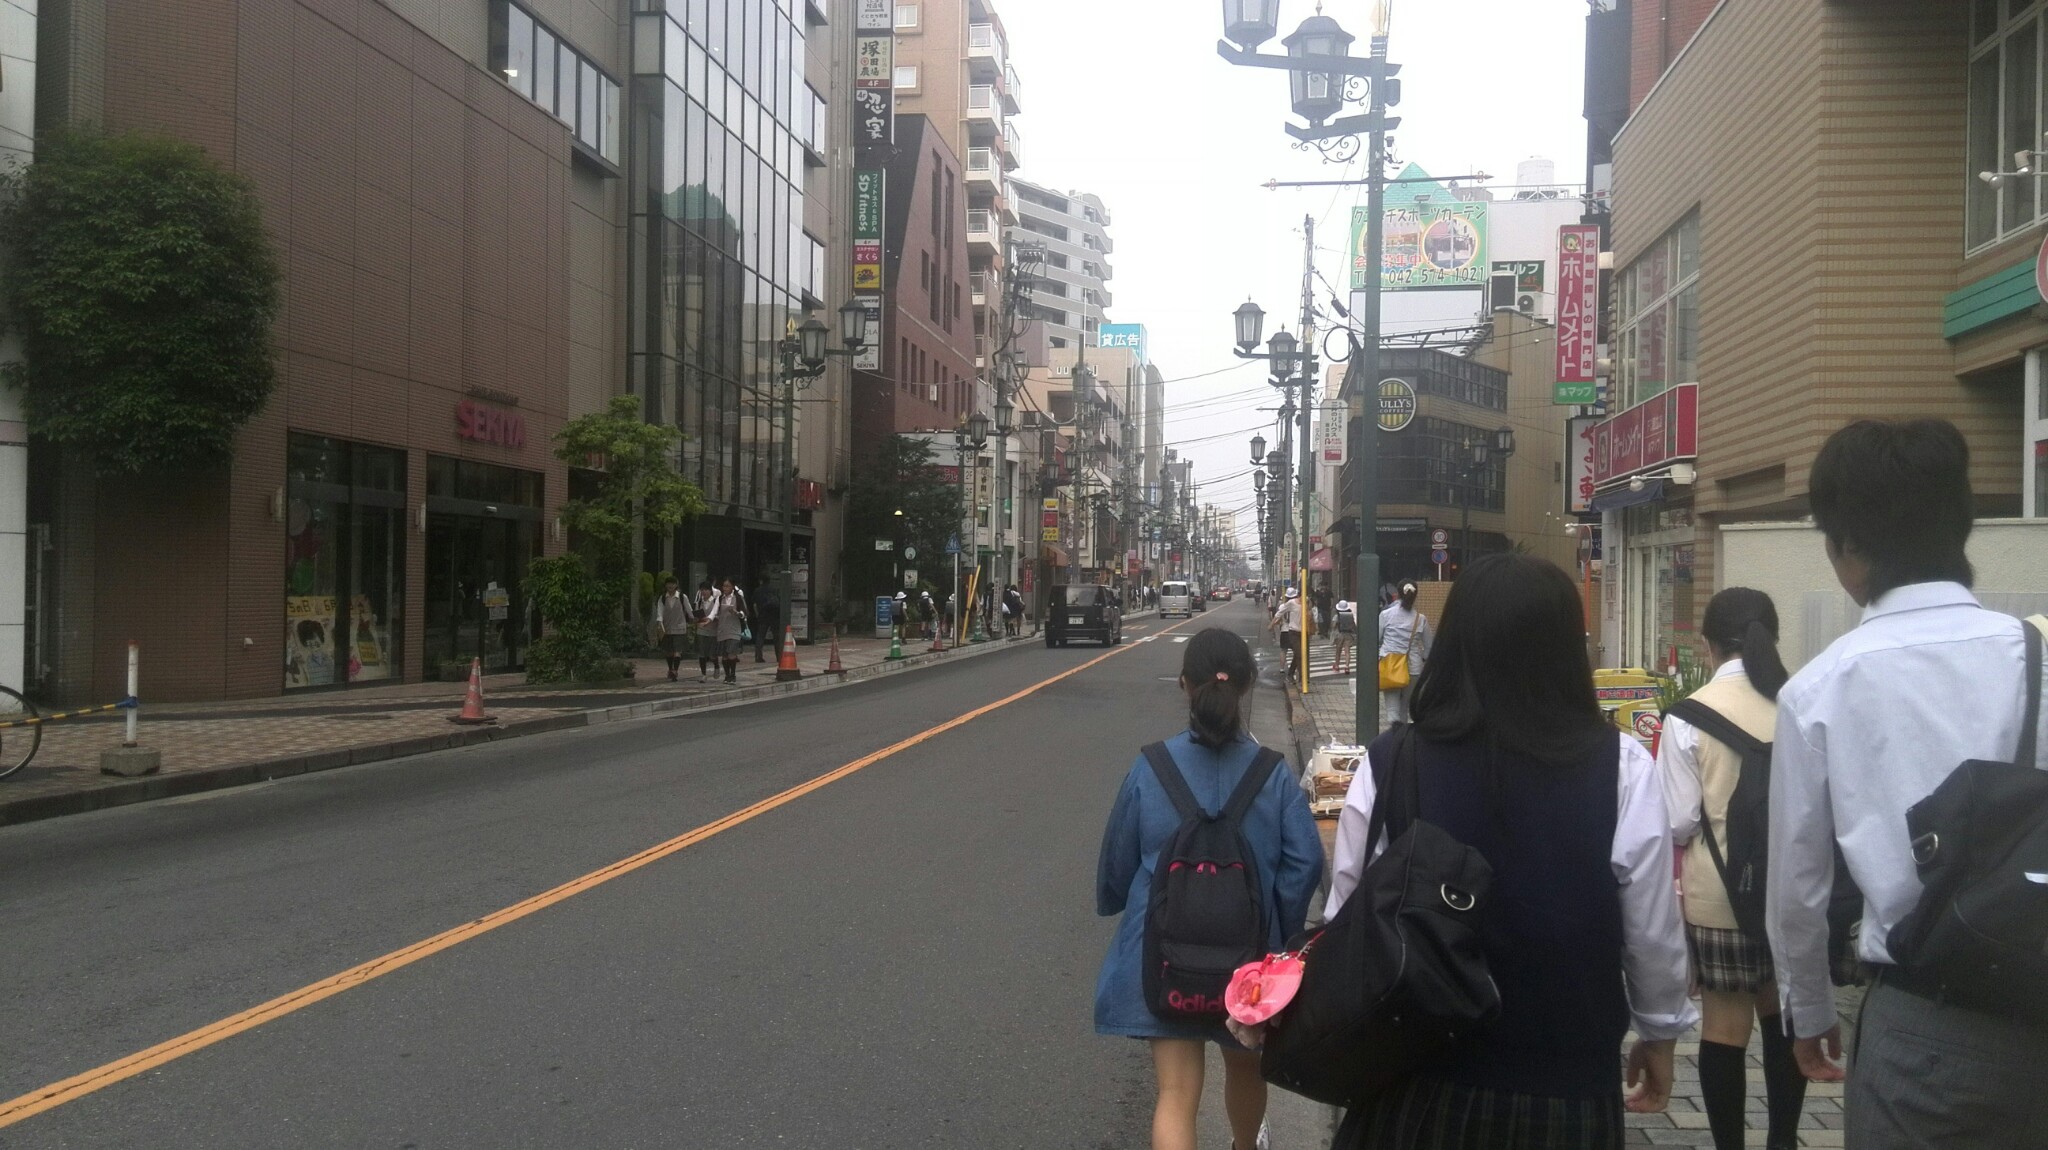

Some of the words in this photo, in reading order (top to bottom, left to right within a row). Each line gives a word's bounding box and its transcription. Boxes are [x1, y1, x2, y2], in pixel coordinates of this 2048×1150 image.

[858, 193, 870, 232] fitness
[856, 253, 878, 261] さくら
[1388, 269, 1413, 284] 042
[1421, 268, 1445, 283] 574
[1454, 266, 1485, 282] 1021
[1560, 257, 1582, 378] ホームメイト
[1101, 333, 1140, 347] 貸広告
[457, 399, 527, 448] SEKIYA
